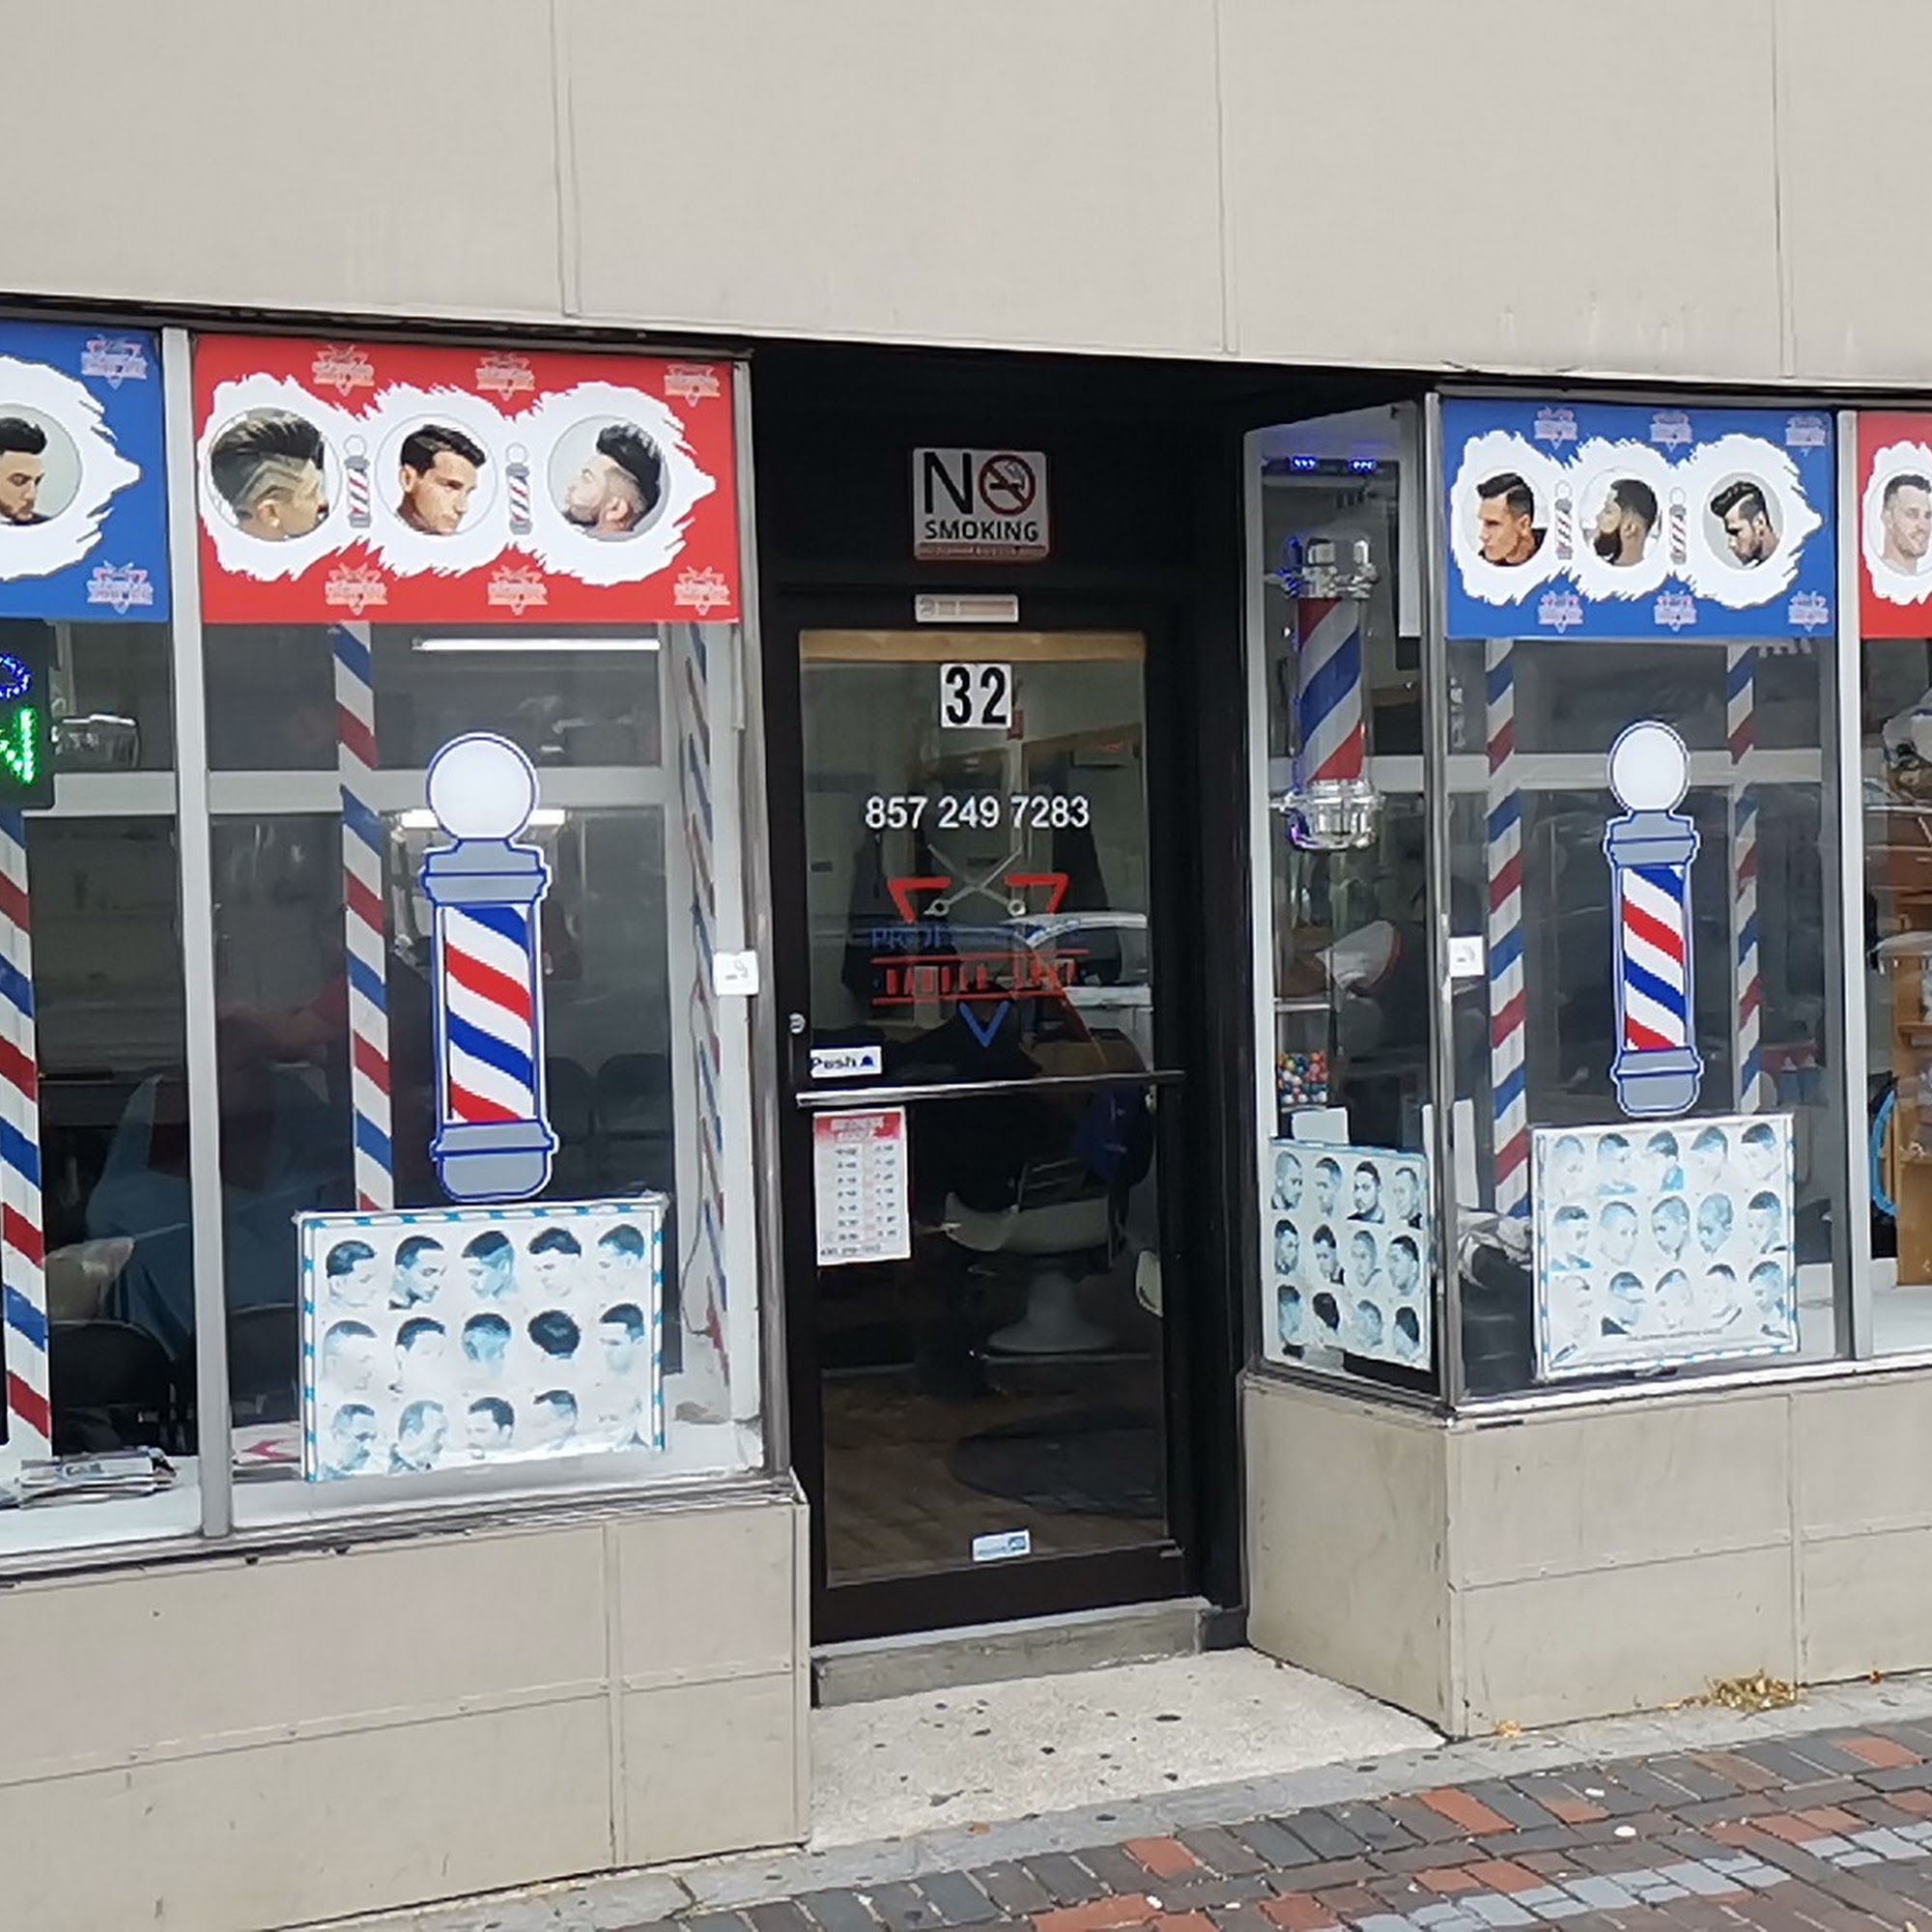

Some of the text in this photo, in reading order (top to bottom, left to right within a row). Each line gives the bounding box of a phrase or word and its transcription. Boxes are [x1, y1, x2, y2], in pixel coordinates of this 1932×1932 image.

[924, 520, 1039, 543] SMOKING
[945, 666, 1009, 724] 32
[866, 795, 1091, 829] 857 249 7283
